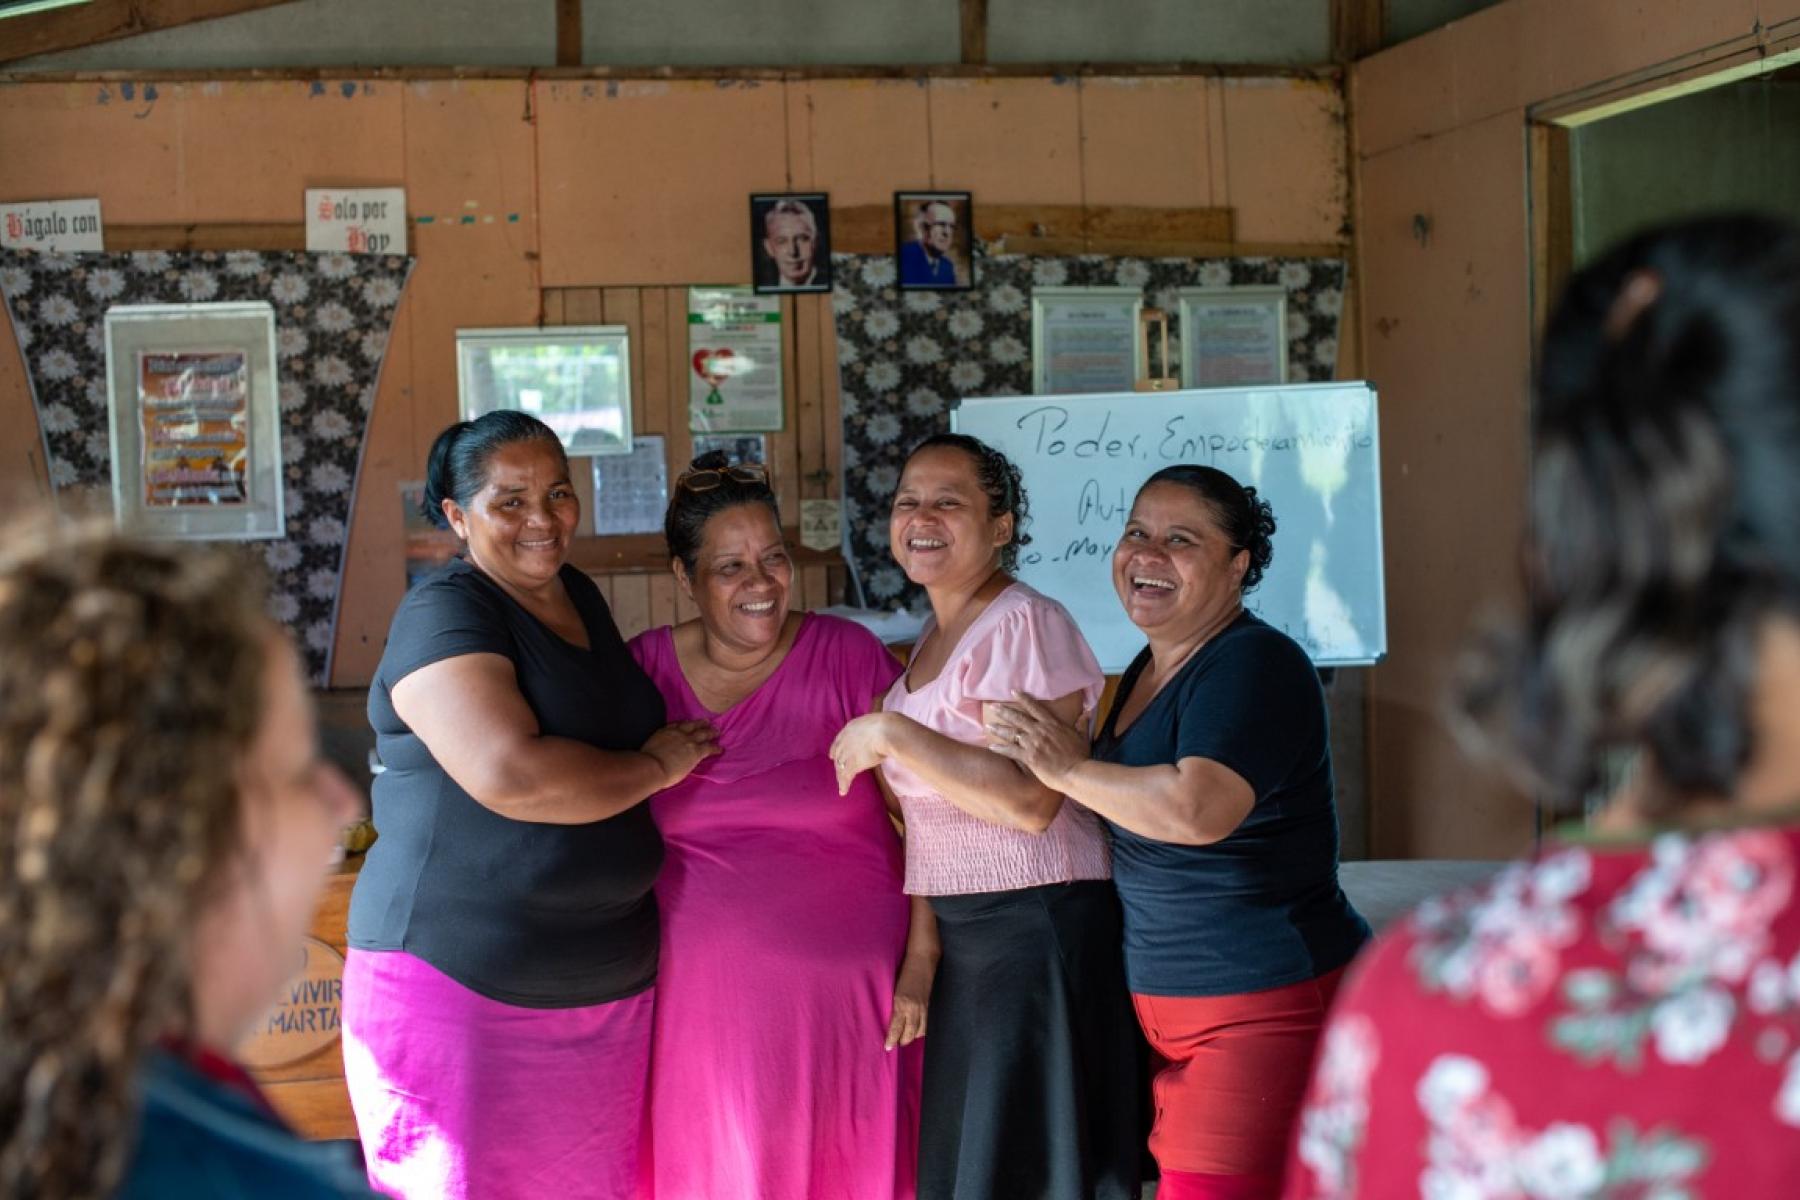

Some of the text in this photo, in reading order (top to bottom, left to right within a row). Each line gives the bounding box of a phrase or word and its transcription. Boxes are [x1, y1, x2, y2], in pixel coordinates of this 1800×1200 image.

[72, 213, 98, 234] con
[317, 195, 388, 224] Solo por
[1078, 478, 1127, 525] Aut
[276, 977, 342, 1006] VIVIR
[266, 1007, 342, 1035] MARTA
